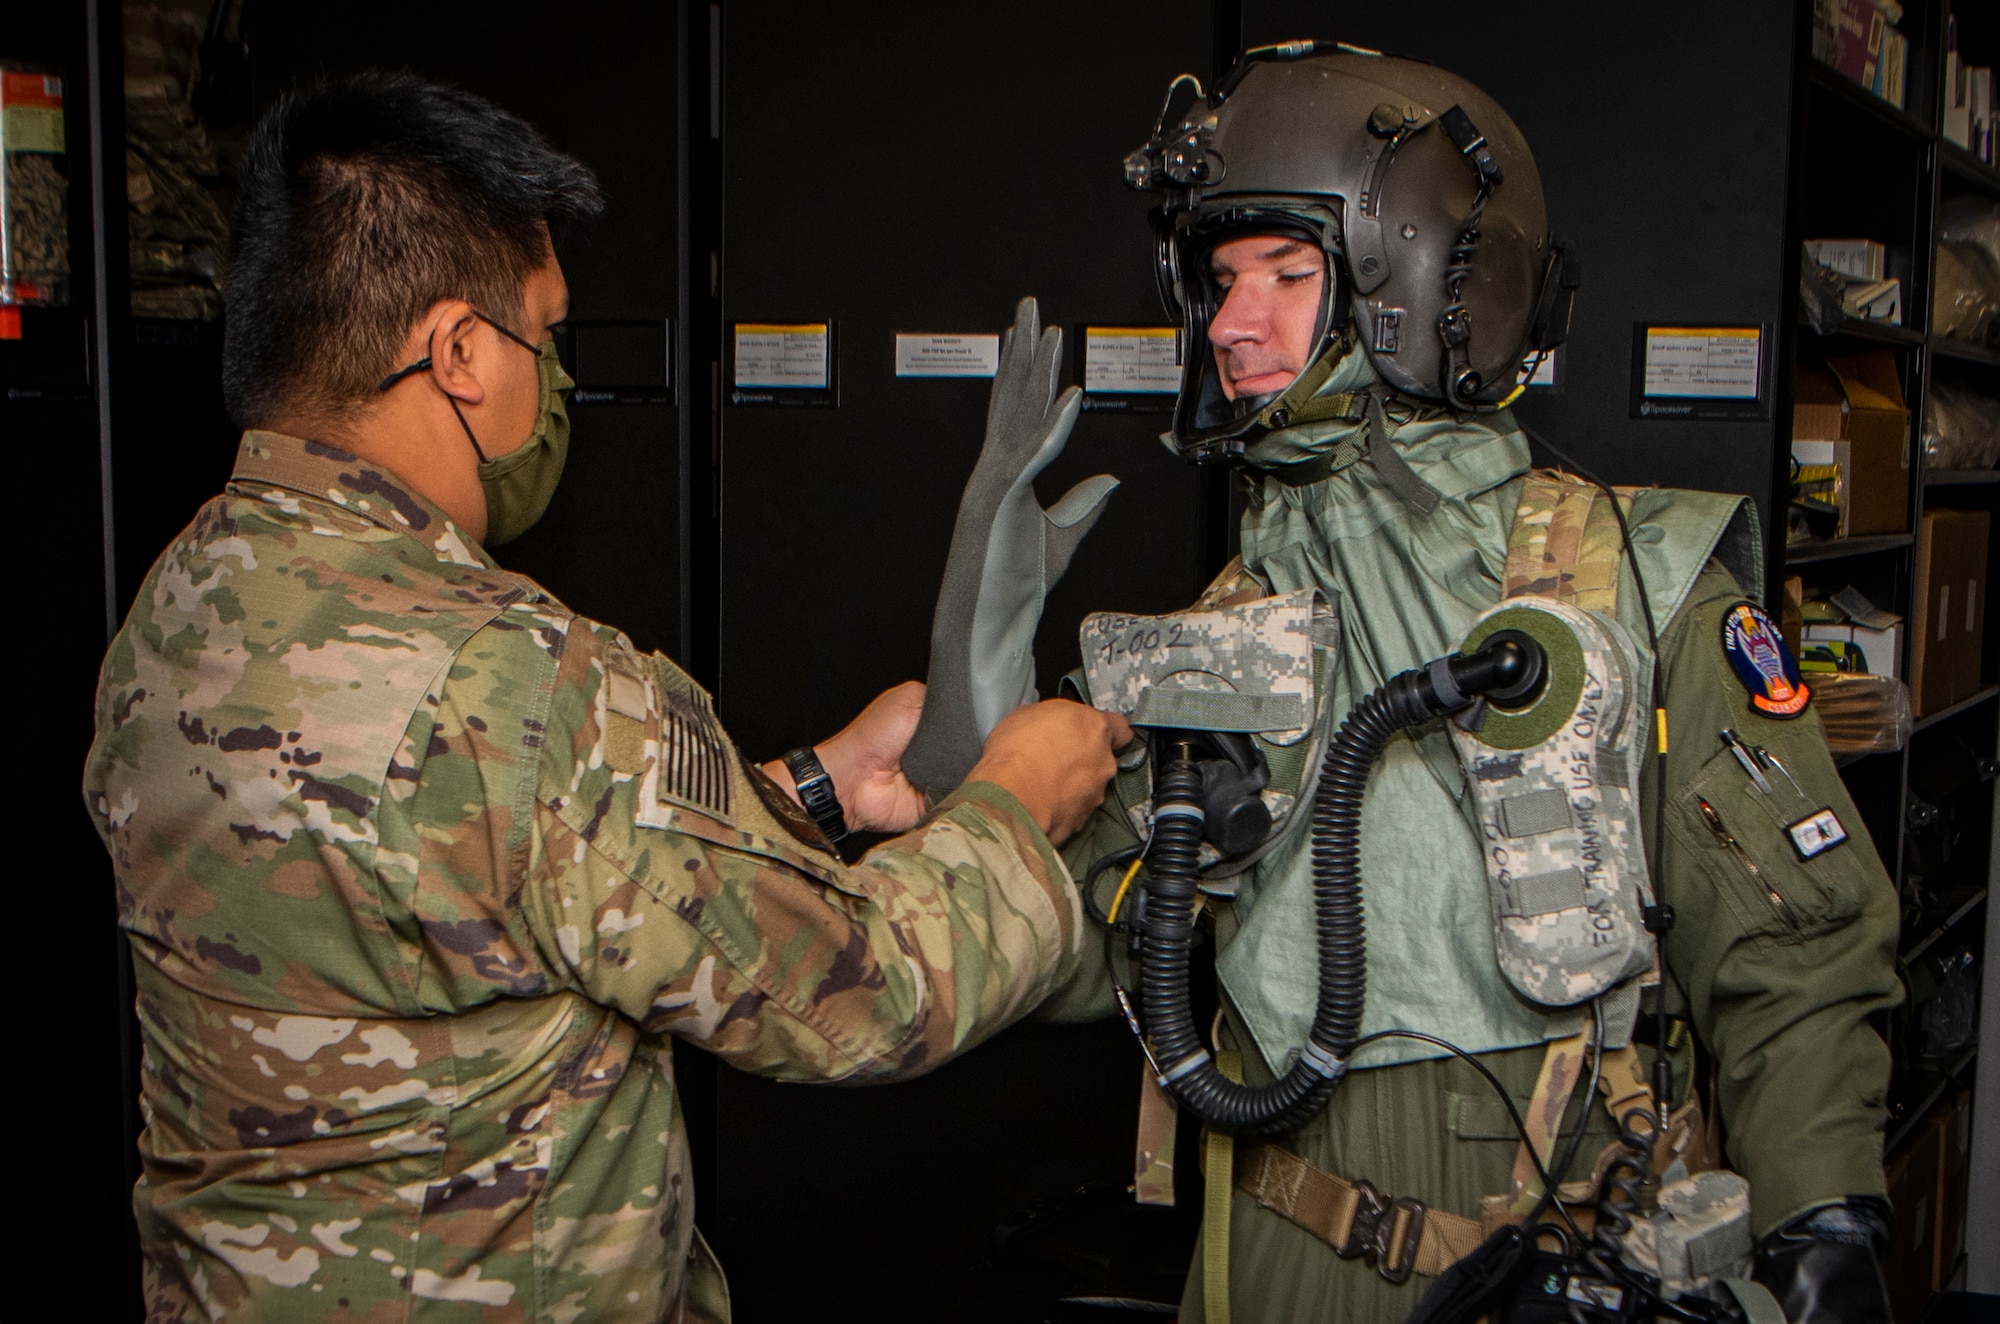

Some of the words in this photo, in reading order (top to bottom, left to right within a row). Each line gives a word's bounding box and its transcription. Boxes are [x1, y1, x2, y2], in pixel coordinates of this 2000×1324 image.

[1651, 402, 1693, 415] Spacesaver
[1101, 622, 1194, 665] T-002
[1572, 672, 1602, 739] ONLY
[1570, 750, 1593, 791] USE
[1572, 796, 1605, 889] TRAINING
[1586, 899, 1614, 948] FOR
